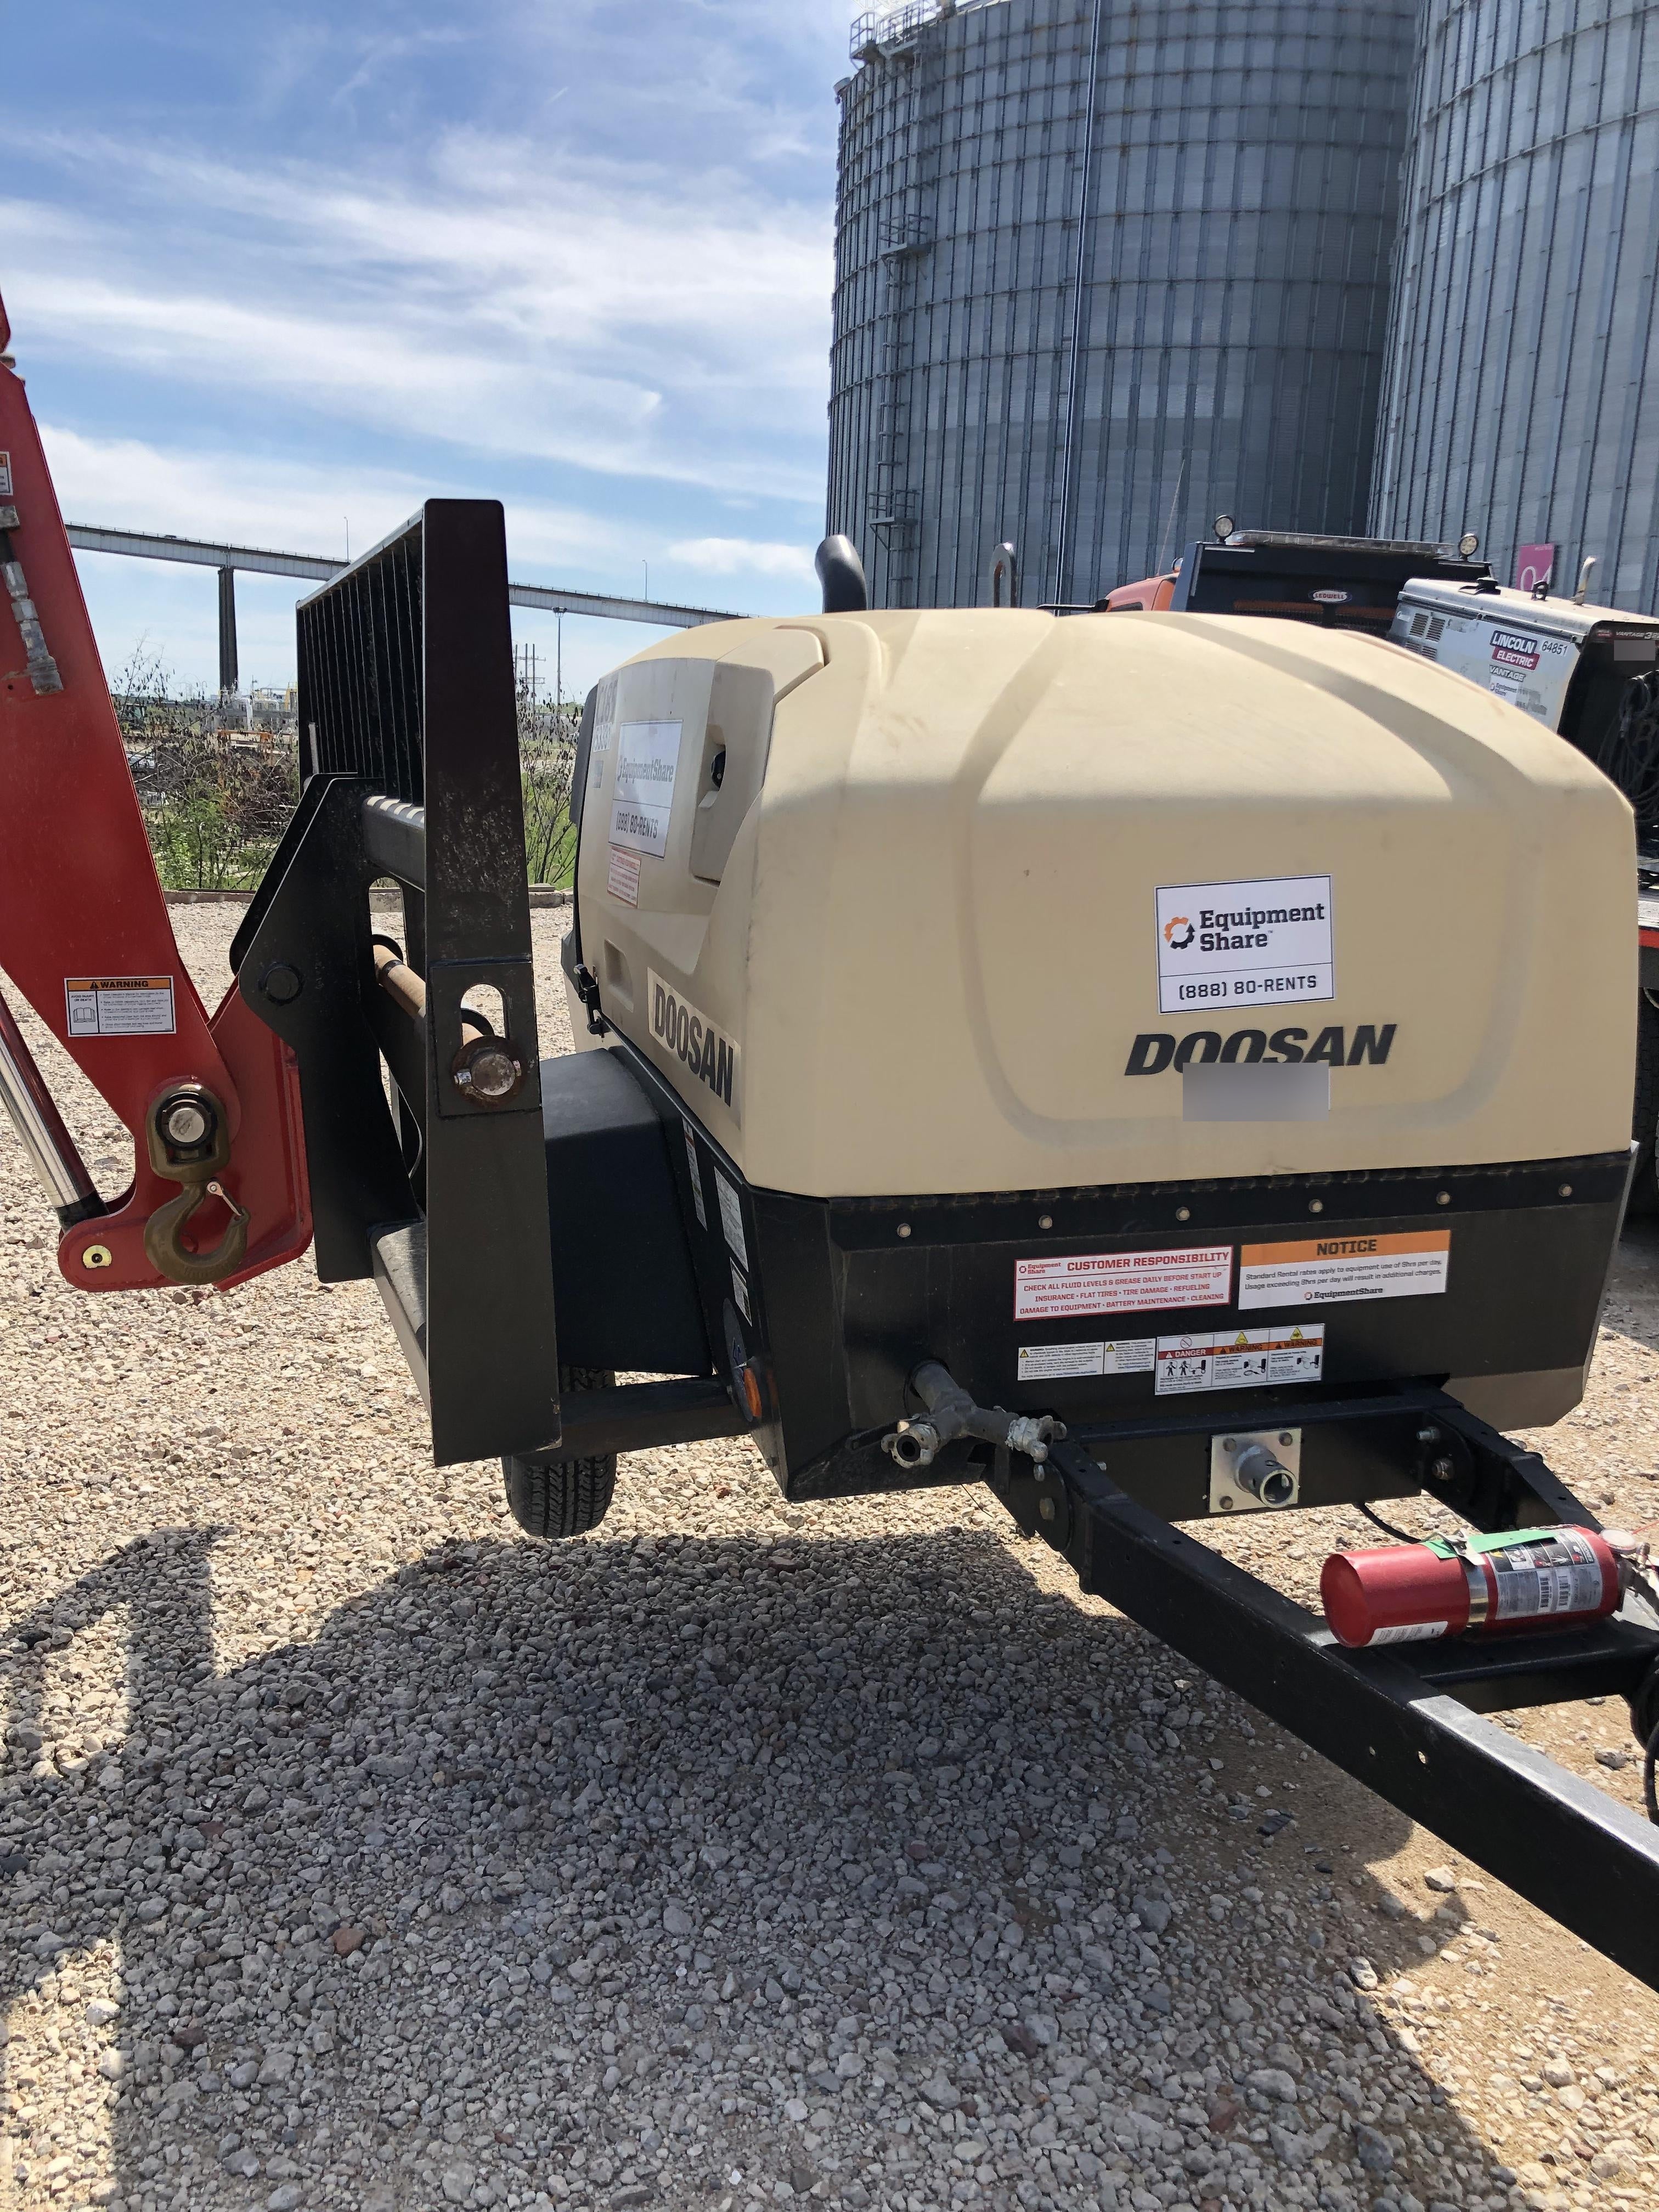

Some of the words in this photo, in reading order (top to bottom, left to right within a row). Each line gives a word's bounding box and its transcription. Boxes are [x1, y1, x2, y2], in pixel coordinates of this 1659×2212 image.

[1492, 633, 1535, 654] LINCOLN
[1542, 641, 1568, 656] 64851
[1497, 650, 1533, 668] ELECTRIC
[1489, 665, 1526, 682] VANTAGE
[622, 758, 674, 784] EquipmentShare
[616, 811, 630, 833] (888)
[630, 815, 658, 839] 80-RENTS
[1199, 903, 1324, 929] Equipment
[1179, 981, 1227, 1000] (888)
[1234, 975, 1317, 995] 80-RENTS
[655, 983, 733, 1107] DOOSAN
[1124, 1024, 1397, 1076] DOOSAN
[1317, 1239, 1377, 1256] NOTICE
[1067, 1259, 1131, 1271] CUSTOMER
[1133, 1252, 1229, 1267] RESPONSIBILITY
[1345, 1264, 1380, 1272] equipment
[1083, 1279, 1107, 1288] LEVELS
[1267, 1280, 1300, 1288] exceeding
[1382, 1271, 1414, 1279] additional
[1035, 1293, 1075, 1302] INSURANCE
[1314, 1288, 1383, 1299] EquipmentShare
[1020, 1306, 1048, 1314] DAMAGE
[1060, 1302, 1101, 1311] EQUIPMENT
[1137, 1296, 1186, 1305] MAINTENANCE
[1175, 1349, 1206, 1358] DANGER
[1229, 1344, 1263, 1353] WARNING
[1284, 1339, 1318, 1348] WARNING
